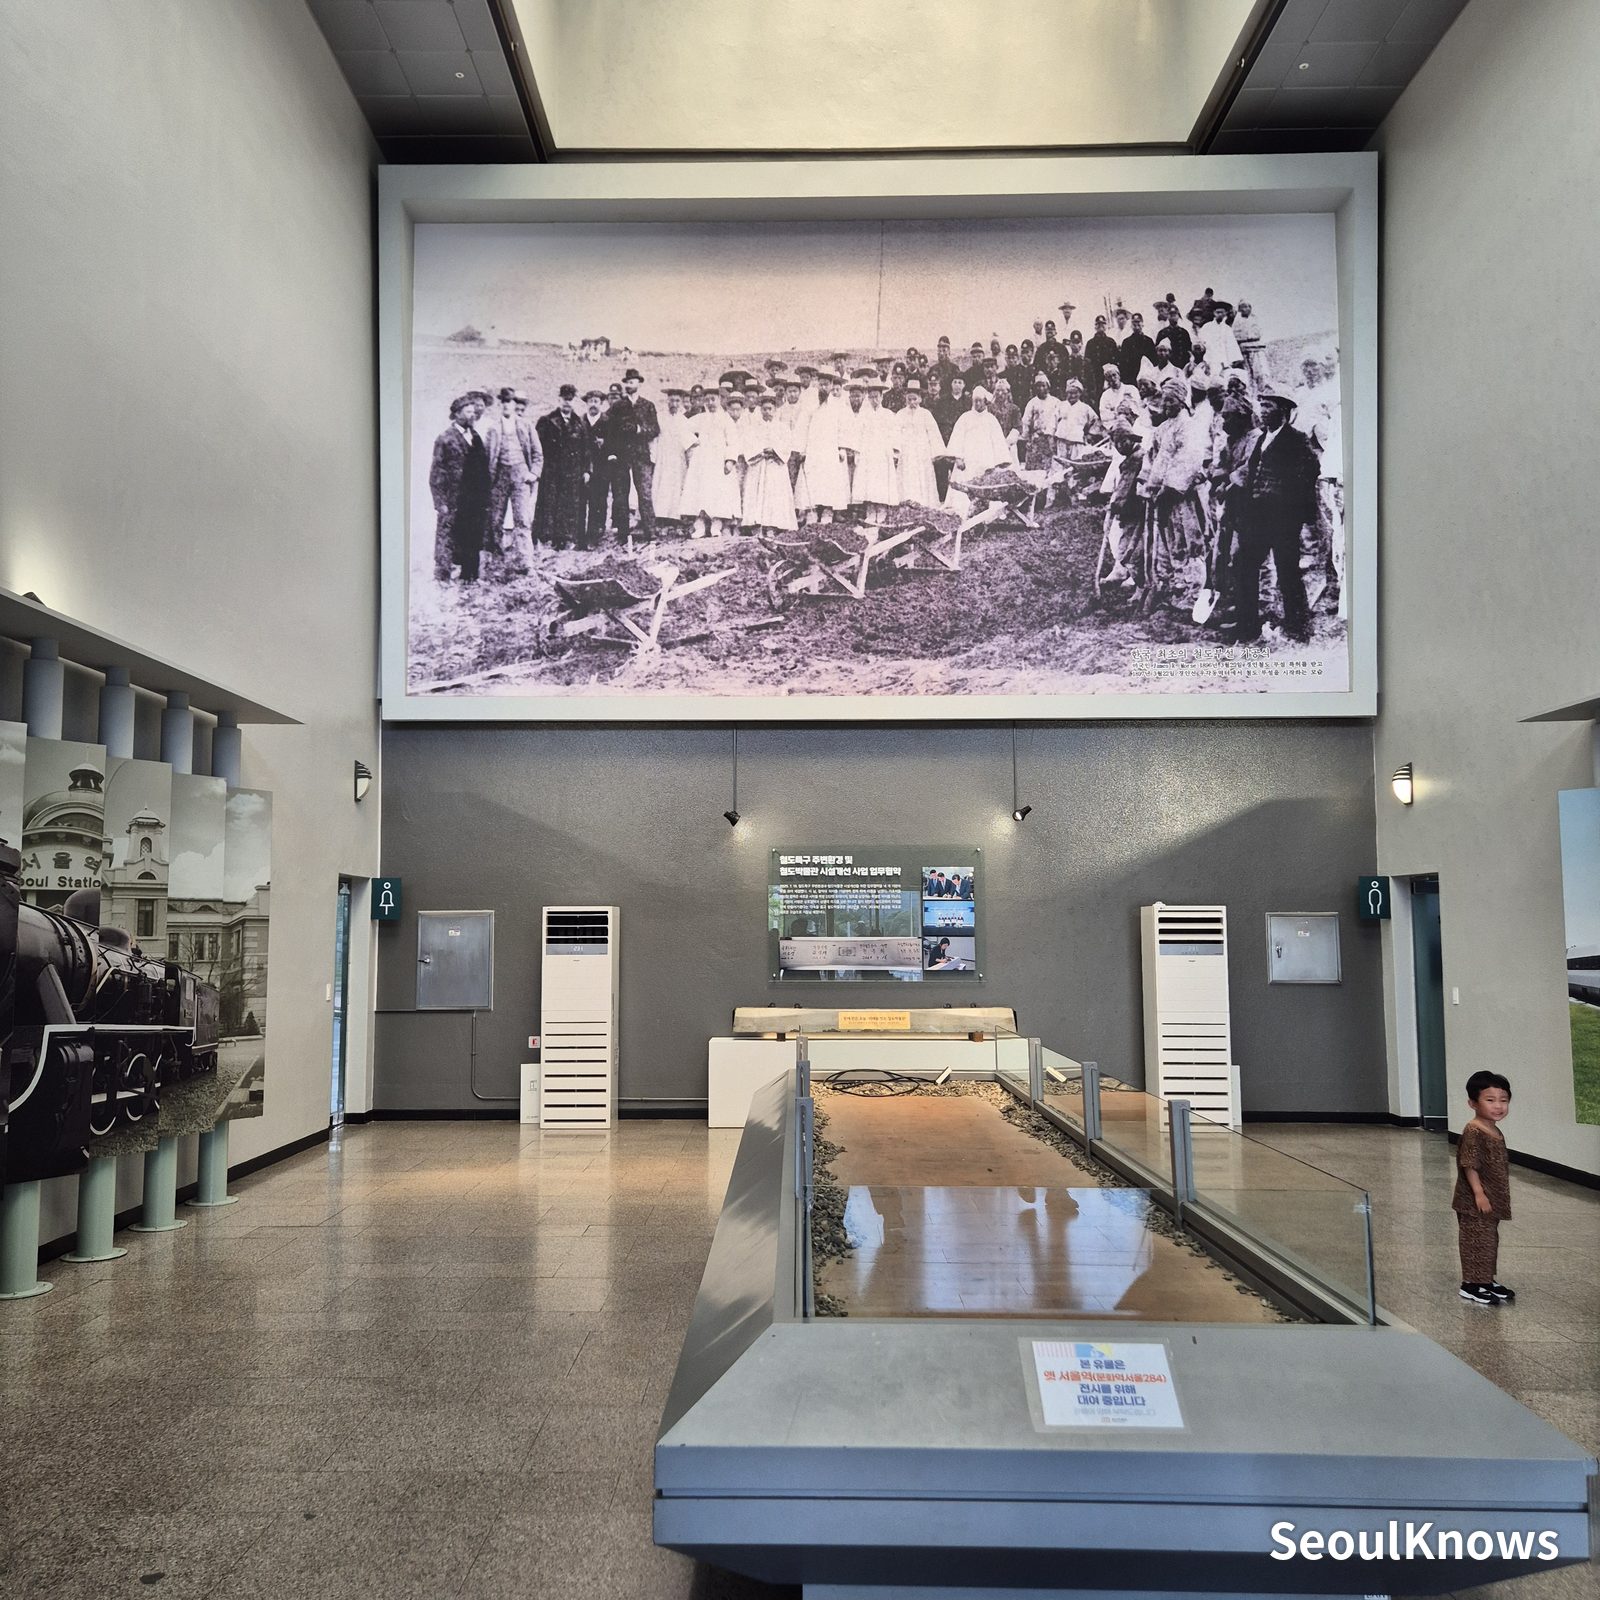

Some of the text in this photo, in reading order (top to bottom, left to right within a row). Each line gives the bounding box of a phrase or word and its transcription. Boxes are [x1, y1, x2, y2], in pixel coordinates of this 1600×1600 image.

[1131, 648, 1151, 660] 한국
[1157, 648, 1187, 660] 최초의
[1240, 647, 1270, 659] 기공식
[845, 855, 853, 865] 및
[780, 867, 902, 876] 철도박물관 시설개선 사업 업무협약
[57, 876, 101, 888] Statio
[1080, 1359, 1126, 1370] 본 유물은
[1044, 1370, 1056, 1381] 옛
[1080, 1384, 1137, 1394] 전시를 위해
[1077, 1396, 1146, 1406] 대여 중입니다
